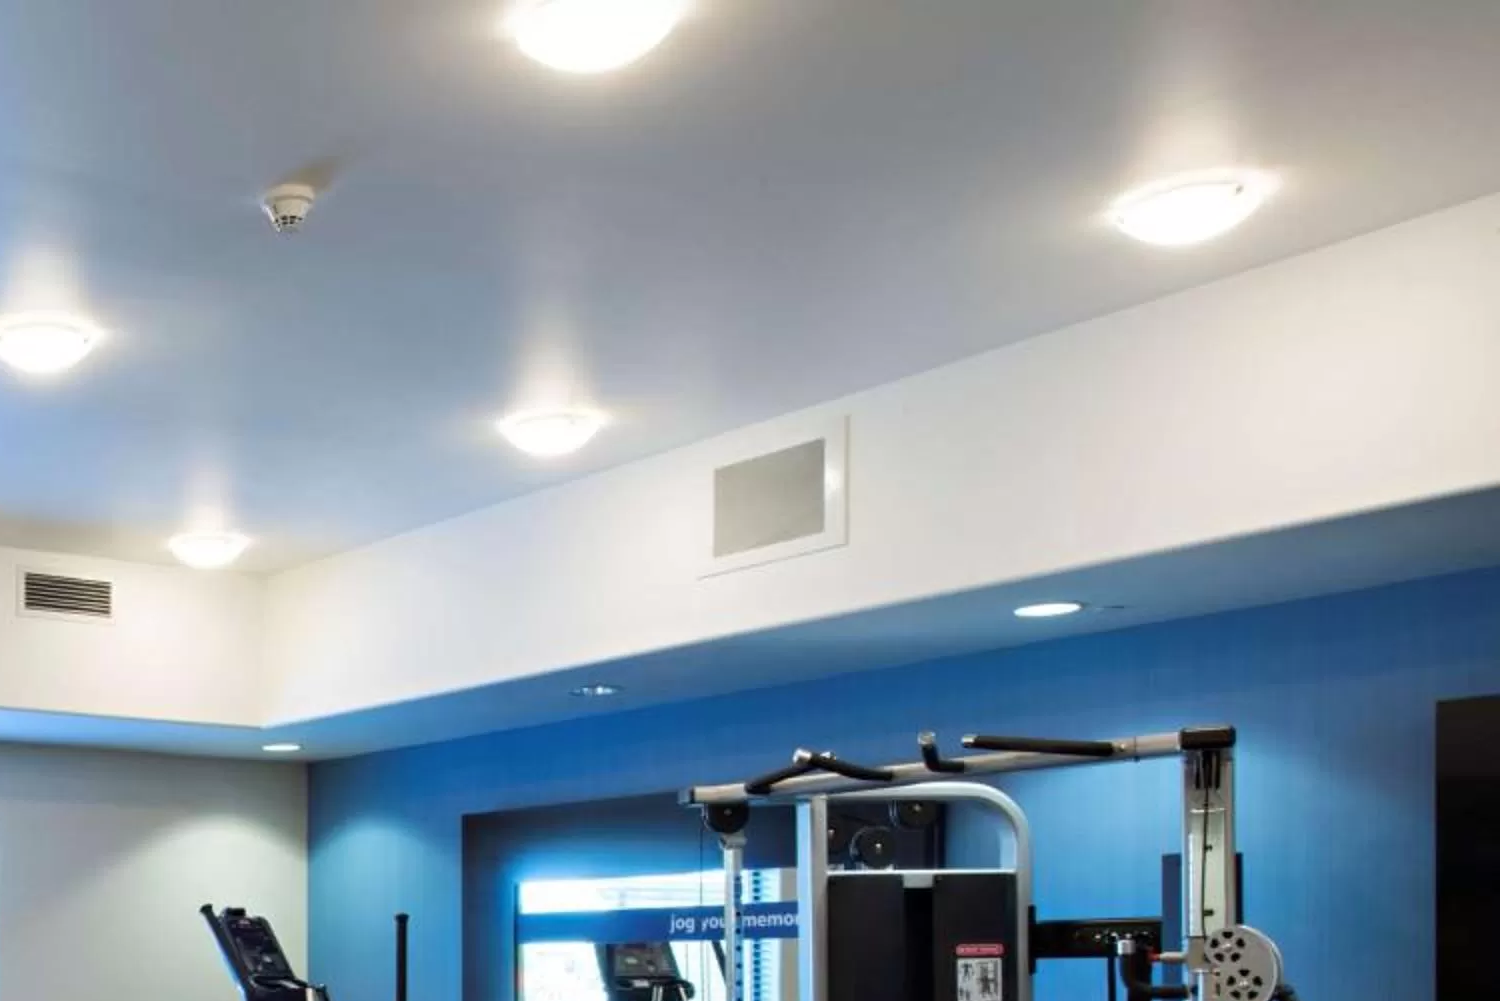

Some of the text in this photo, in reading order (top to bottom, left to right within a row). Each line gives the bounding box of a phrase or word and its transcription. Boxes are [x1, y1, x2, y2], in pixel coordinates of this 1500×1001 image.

[669, 912, 799, 934] jog you memo
